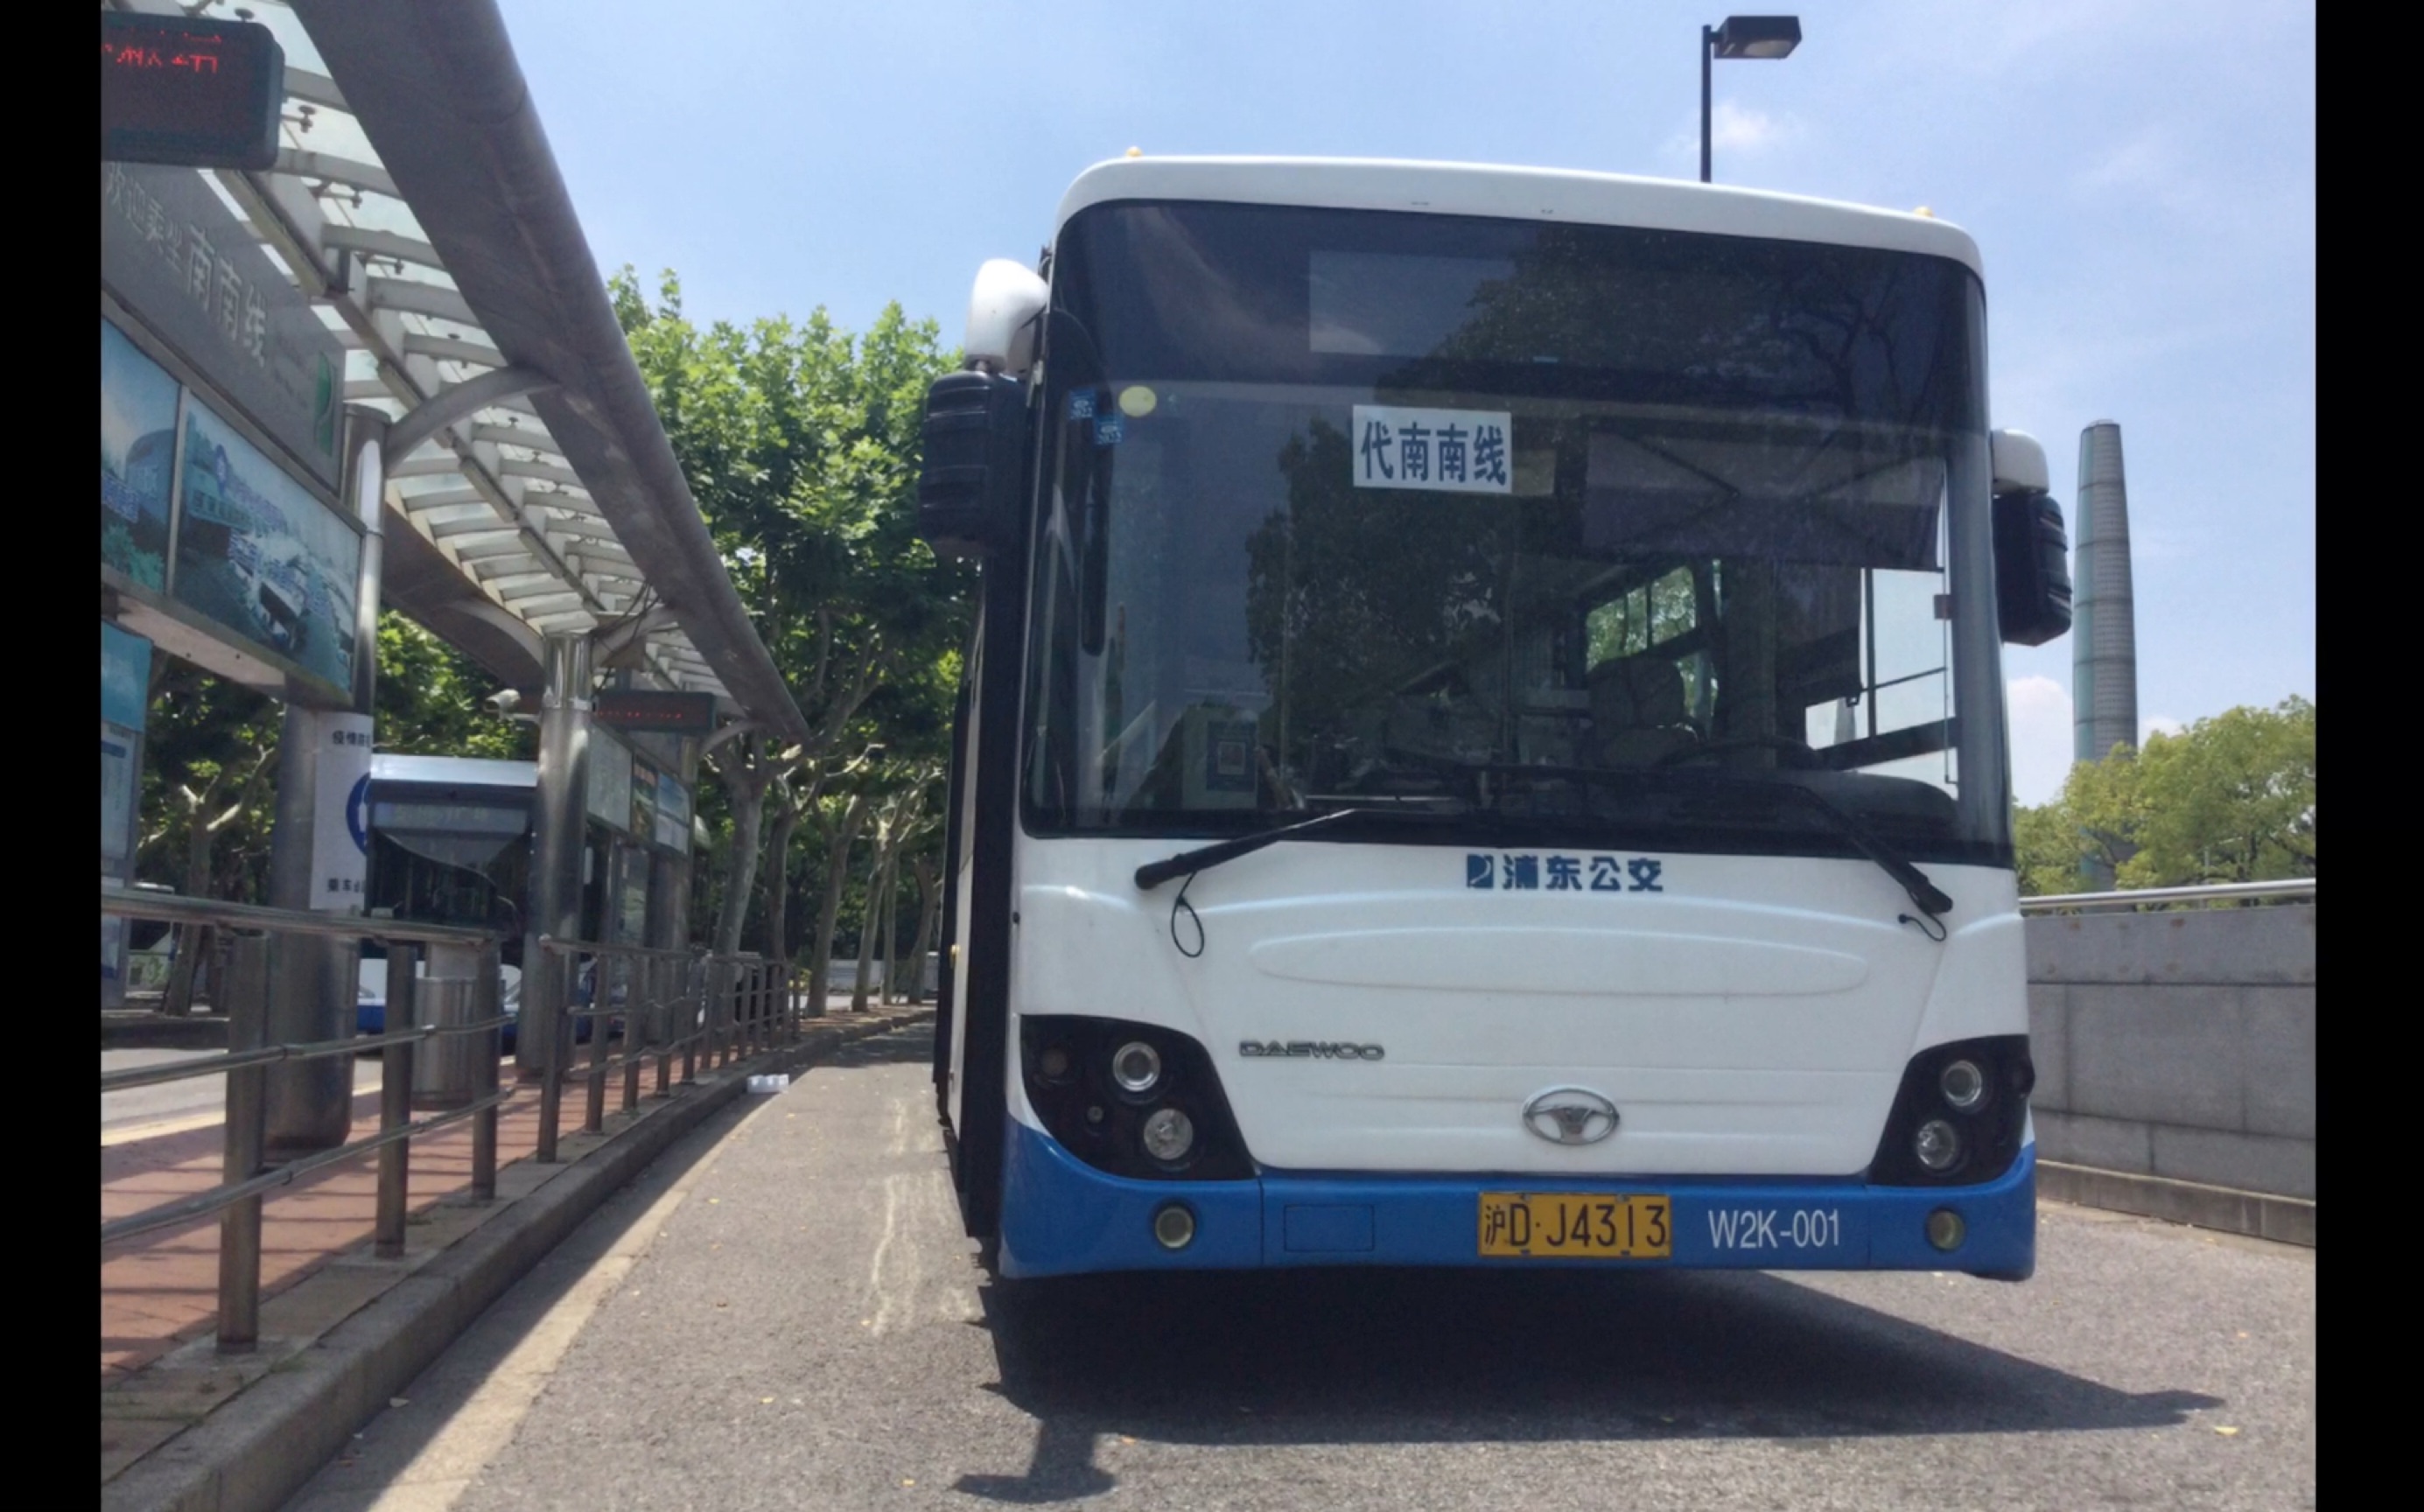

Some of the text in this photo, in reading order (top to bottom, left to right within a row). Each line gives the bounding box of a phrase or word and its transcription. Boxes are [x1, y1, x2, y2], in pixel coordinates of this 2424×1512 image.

[1361, 420, 1507, 486] 代南南线
[1502, 853, 1663, 892] 浦东公交
[1239, 1040, 1385, 1061] DAEWOO
[1707, 1208, 1839, 1250] W2K-001
